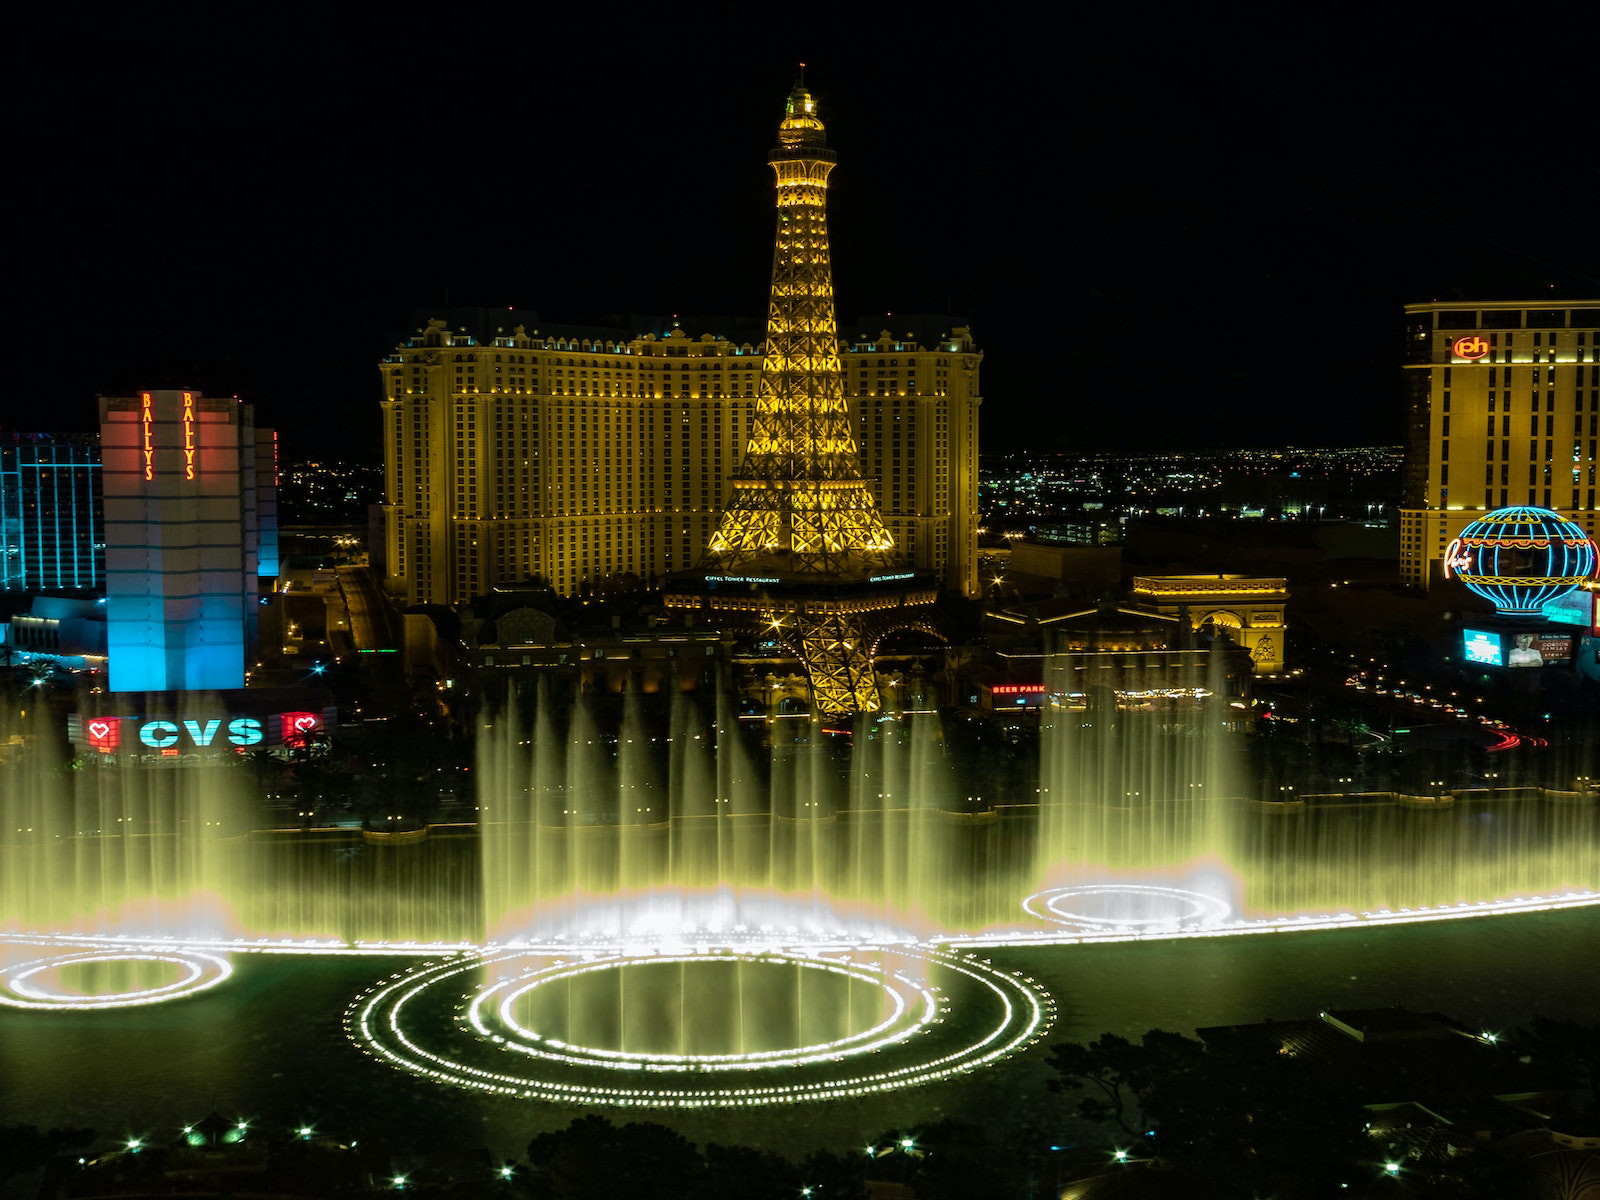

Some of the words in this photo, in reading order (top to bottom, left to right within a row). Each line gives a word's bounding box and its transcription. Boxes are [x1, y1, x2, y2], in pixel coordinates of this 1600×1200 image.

[1459, 337, 1488, 355] ph
[142, 393, 153, 480] BALLYS
[183, 393, 195, 480] BALLYS
[139, 718, 263, 748] CVS
